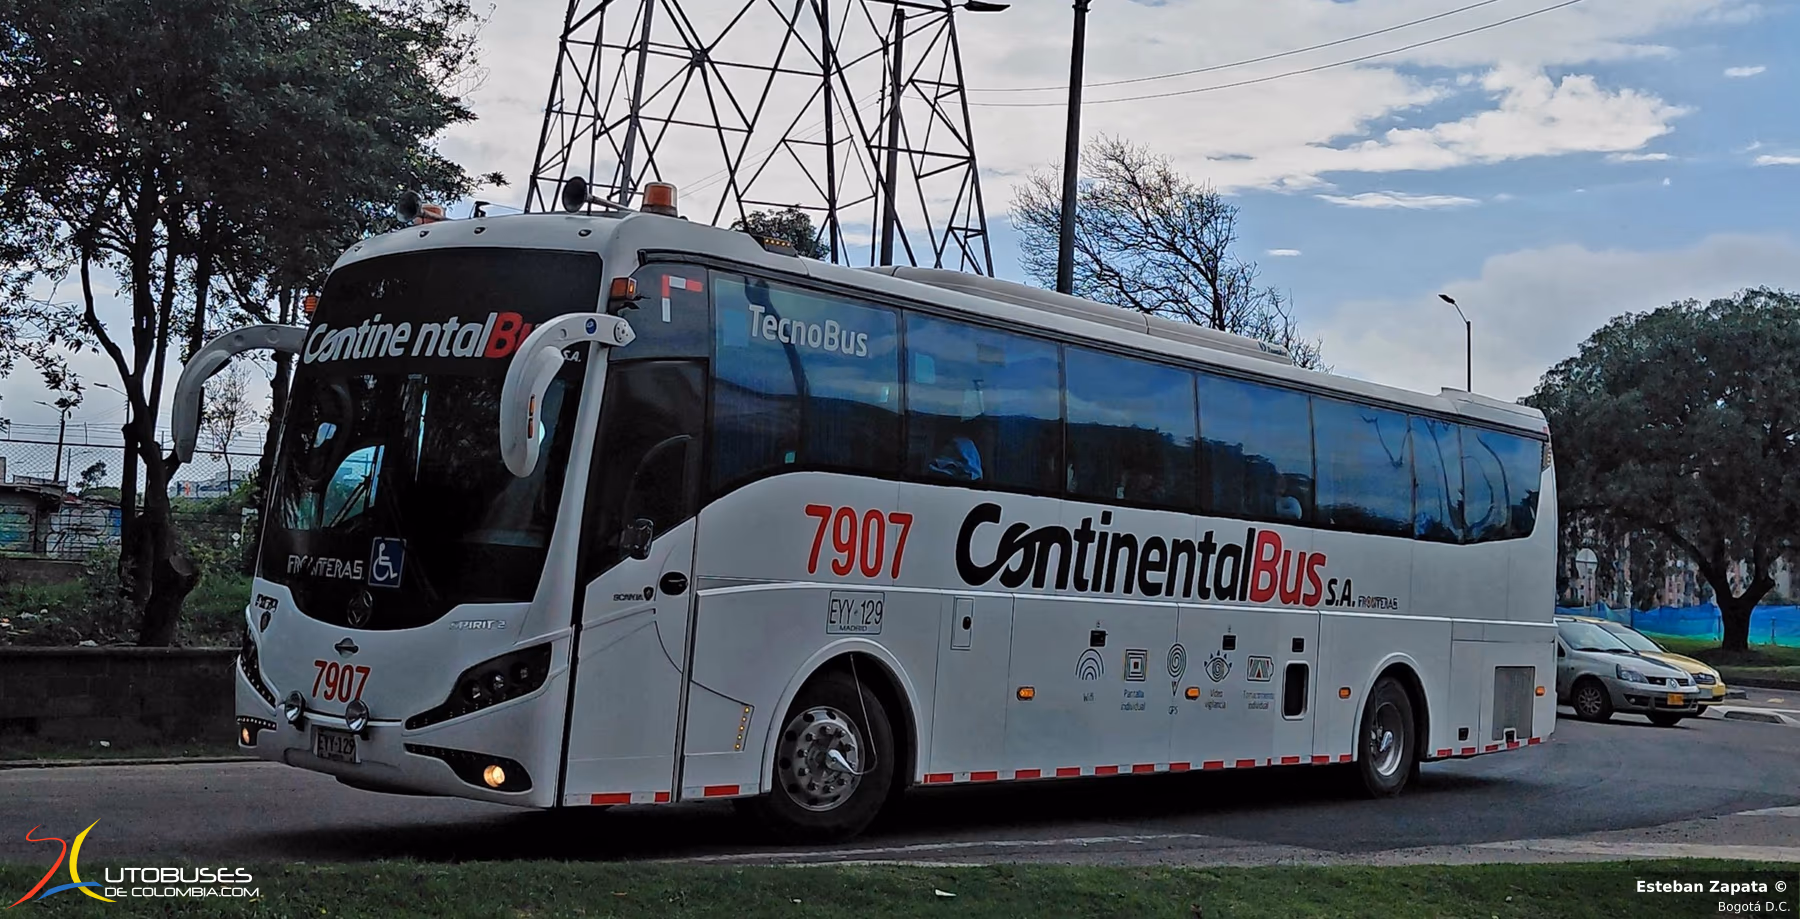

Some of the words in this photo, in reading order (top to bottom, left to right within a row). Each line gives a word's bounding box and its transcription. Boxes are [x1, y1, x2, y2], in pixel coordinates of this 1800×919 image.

[749, 304, 868, 357] TecnoBus
[804, 503, 914, 579] 7907
[955, 502, 1327, 607] ContinentalBus
[1325, 578, 1356, 607] S.A.
[312, 659, 372, 703] 7907
